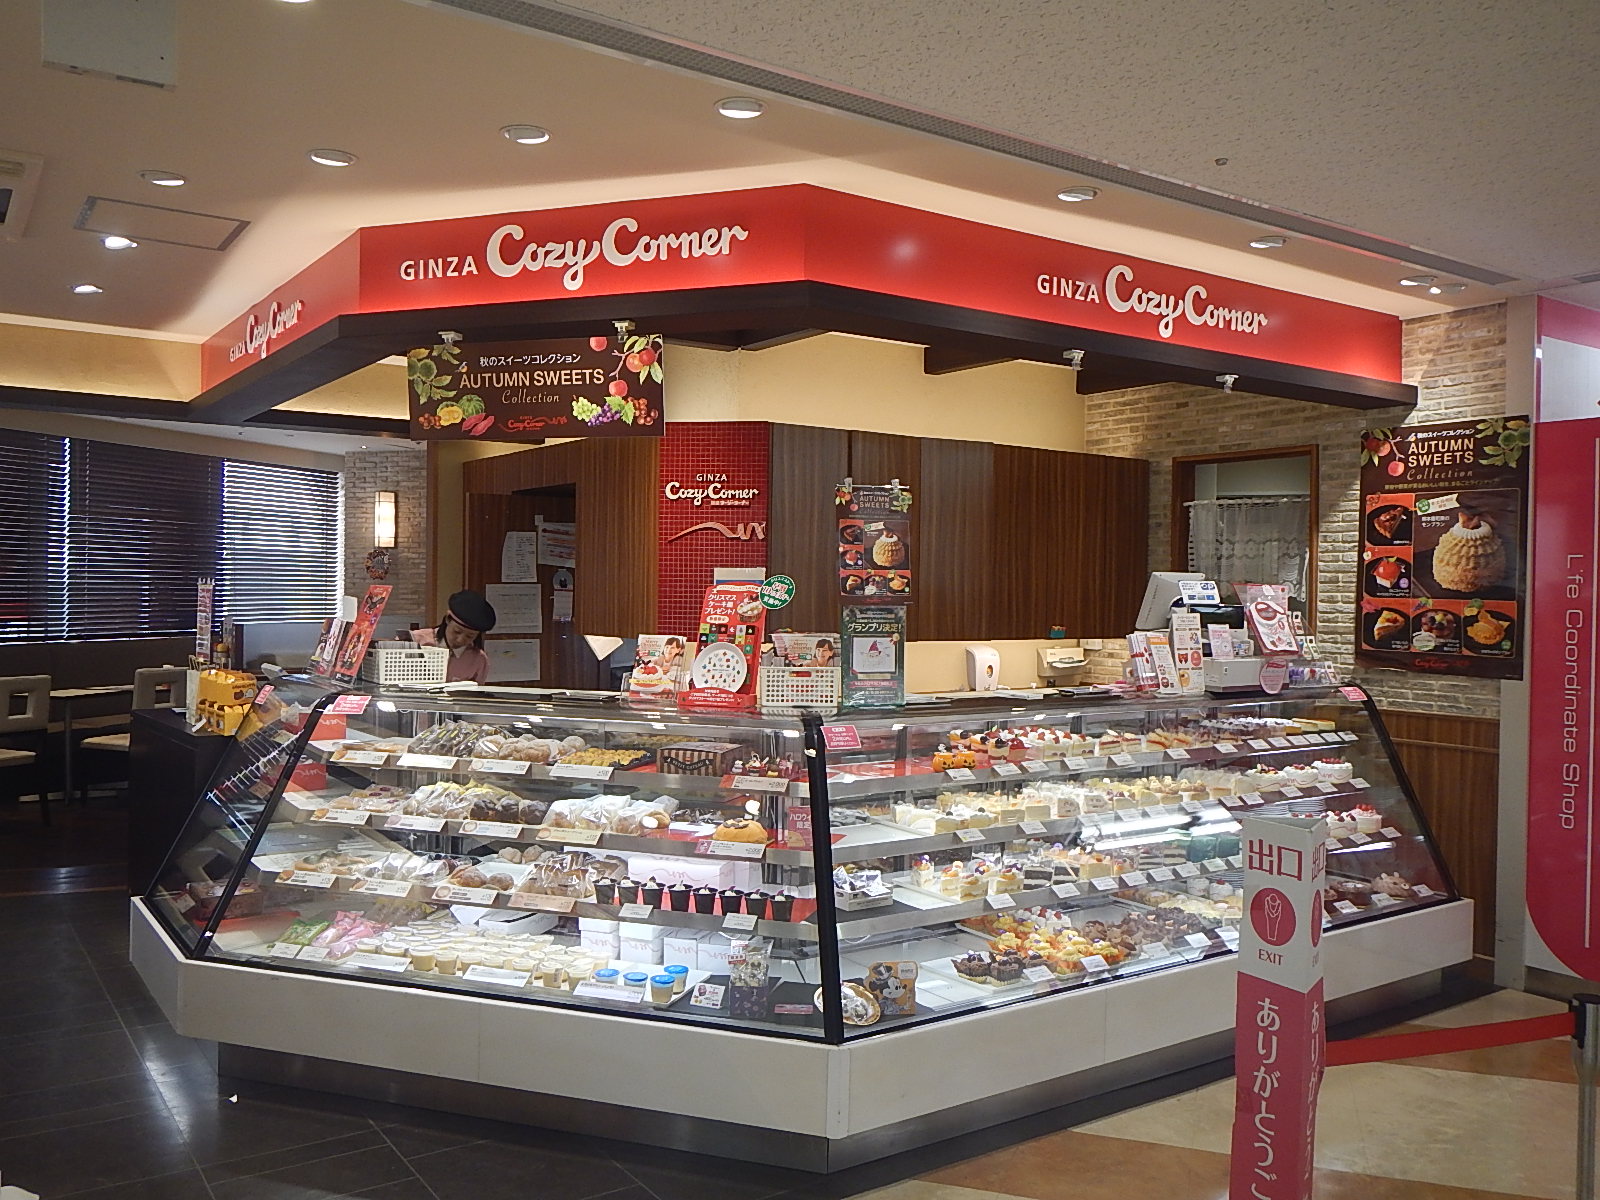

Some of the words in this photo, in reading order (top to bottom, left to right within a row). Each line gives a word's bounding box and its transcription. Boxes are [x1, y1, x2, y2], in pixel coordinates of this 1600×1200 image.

[400, 256, 478, 281] GINZA
[486, 224, 600, 291] Cozy
[602, 217, 748, 266] Corner
[1037, 274, 1099, 303] GINZA
[1105, 264, 1183, 338] Cozy
[1184, 285, 1268, 335] Corner
[230, 341, 246, 362] GINZA
[246, 314, 270, 360] Cozy
[268, 300, 302, 339] Corner
[479, 353, 581, 368] 秋のスイーツコレクション
[459, 370, 530, 389] AUTUMN
[533, 369, 605, 386] SWEETS
[502, 389, 560, 404] Collection
[1408, 438, 1474, 454] AUTUMN
[1408, 451, 1474, 467] SWEETS
[1406, 468, 1473, 480] Collection
[665, 481, 708, 506] Cozy
[708, 483, 759, 499] Corner
[859, 495, 890, 503] AUTUMN
[847, 623, 902, 632] グランプリ決定!
[1563, 609, 1583, 753] Coordinate
[1558, 763, 1580, 830] Shop
[1248, 838, 1302, 881] 出口
[1311, 840, 1325, 883] 出口
[1258, 948, 1283, 966] EXIT
